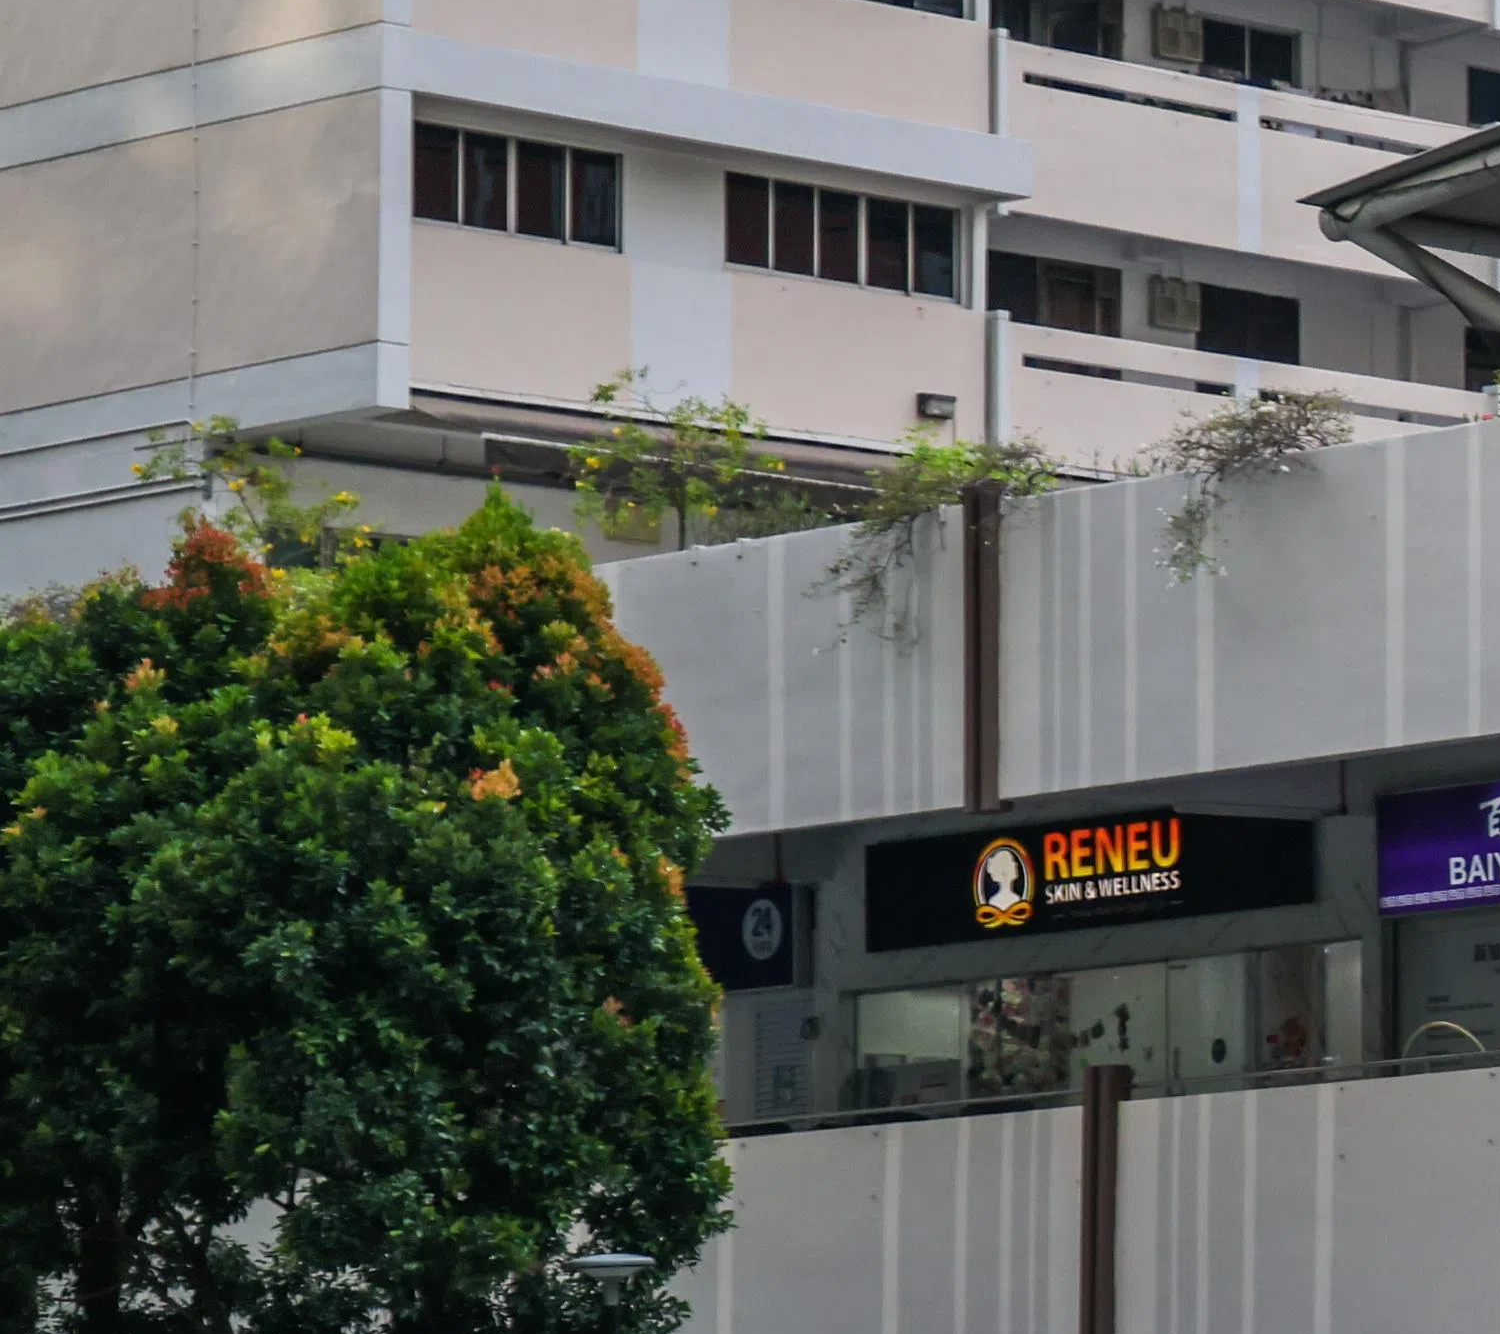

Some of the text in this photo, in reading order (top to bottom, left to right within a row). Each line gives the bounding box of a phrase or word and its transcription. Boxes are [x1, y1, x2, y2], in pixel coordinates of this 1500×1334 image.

[1043, 818, 1182, 881] RENEU
[1044, 870, 1182, 905] SKIN & WELLNESS
[751, 907, 773, 937] 24
